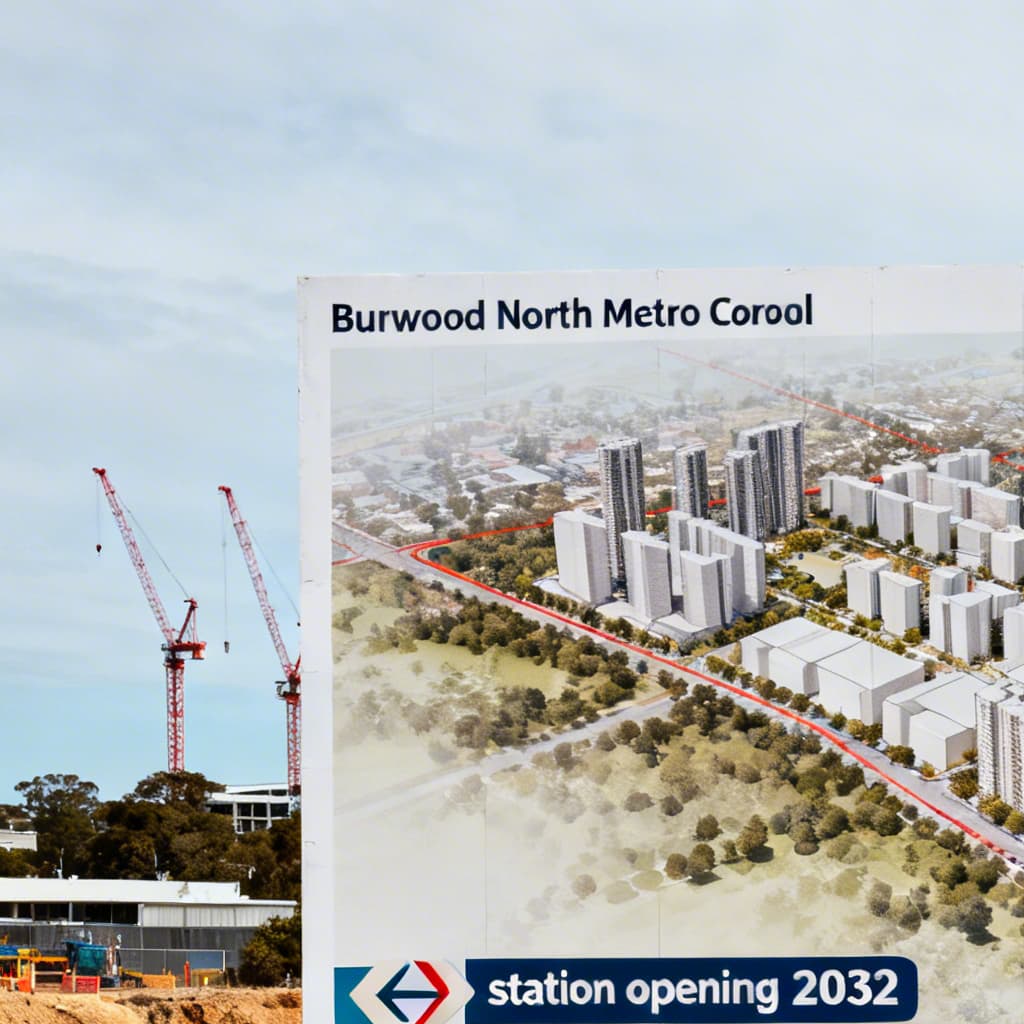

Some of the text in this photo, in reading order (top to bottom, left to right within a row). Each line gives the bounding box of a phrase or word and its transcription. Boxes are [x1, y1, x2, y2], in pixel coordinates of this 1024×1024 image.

[332, 301, 485, 333] Burwood
[497, 298, 592, 330] North
[603, 297, 700, 327] Metro
[487, 968, 899, 1014] station opening 2032
